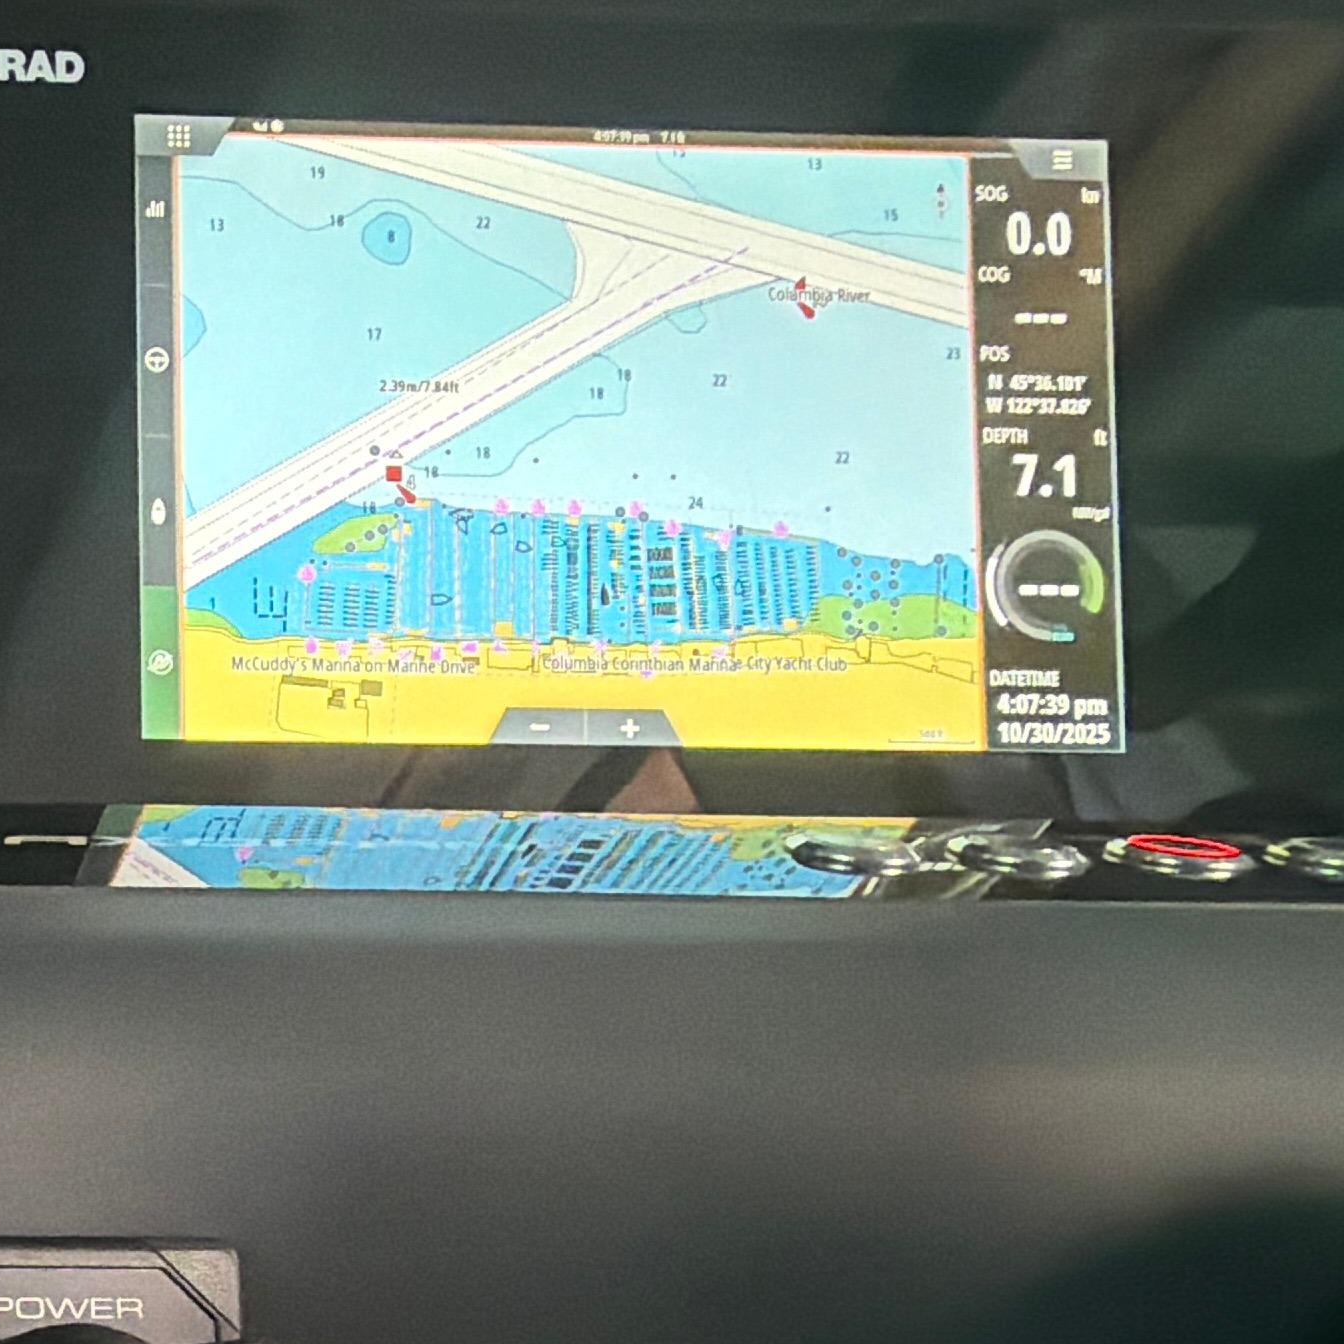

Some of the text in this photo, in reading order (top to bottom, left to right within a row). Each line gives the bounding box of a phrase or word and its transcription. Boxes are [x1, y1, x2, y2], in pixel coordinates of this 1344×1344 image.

[975, 185, 1009, 202] SOG
[476, 216, 490, 229] 22
[884, 209, 898, 222] 15
[1006, 211, 1072, 256] 0.0
[978, 266, 1011, 283] COG
[838, 288, 871, 303] River
[367, 327, 382, 341] 17
[980, 345, 1011, 362] POS
[379, 379, 460, 394] 2.39m/7.84ft
[712, 374, 727, 387] 22
[988, 374, 1004, 391] N
[590, 387, 604, 399] 18
[985, 398, 1005, 414] W
[983, 427, 1028, 444] DEPTH
[476, 446, 490, 459] 18
[835, 452, 849, 464] 22
[425, 466, 439, 478] 18
[1012, 453, 1076, 498] 7.1
[688, 497, 704, 509] 24
[232, 658, 307, 675] McCuddy's
[365, 661, 383, 672] on
[746, 657, 772, 674] City
[776, 657, 812, 671] Yacht
[816, 657, 847, 671] Club
[989, 669, 1060, 688] DATETIME
[997, 693, 1108, 720] 4:07:39 pm
[997, 722, 1111, 745] 10/30/2025
